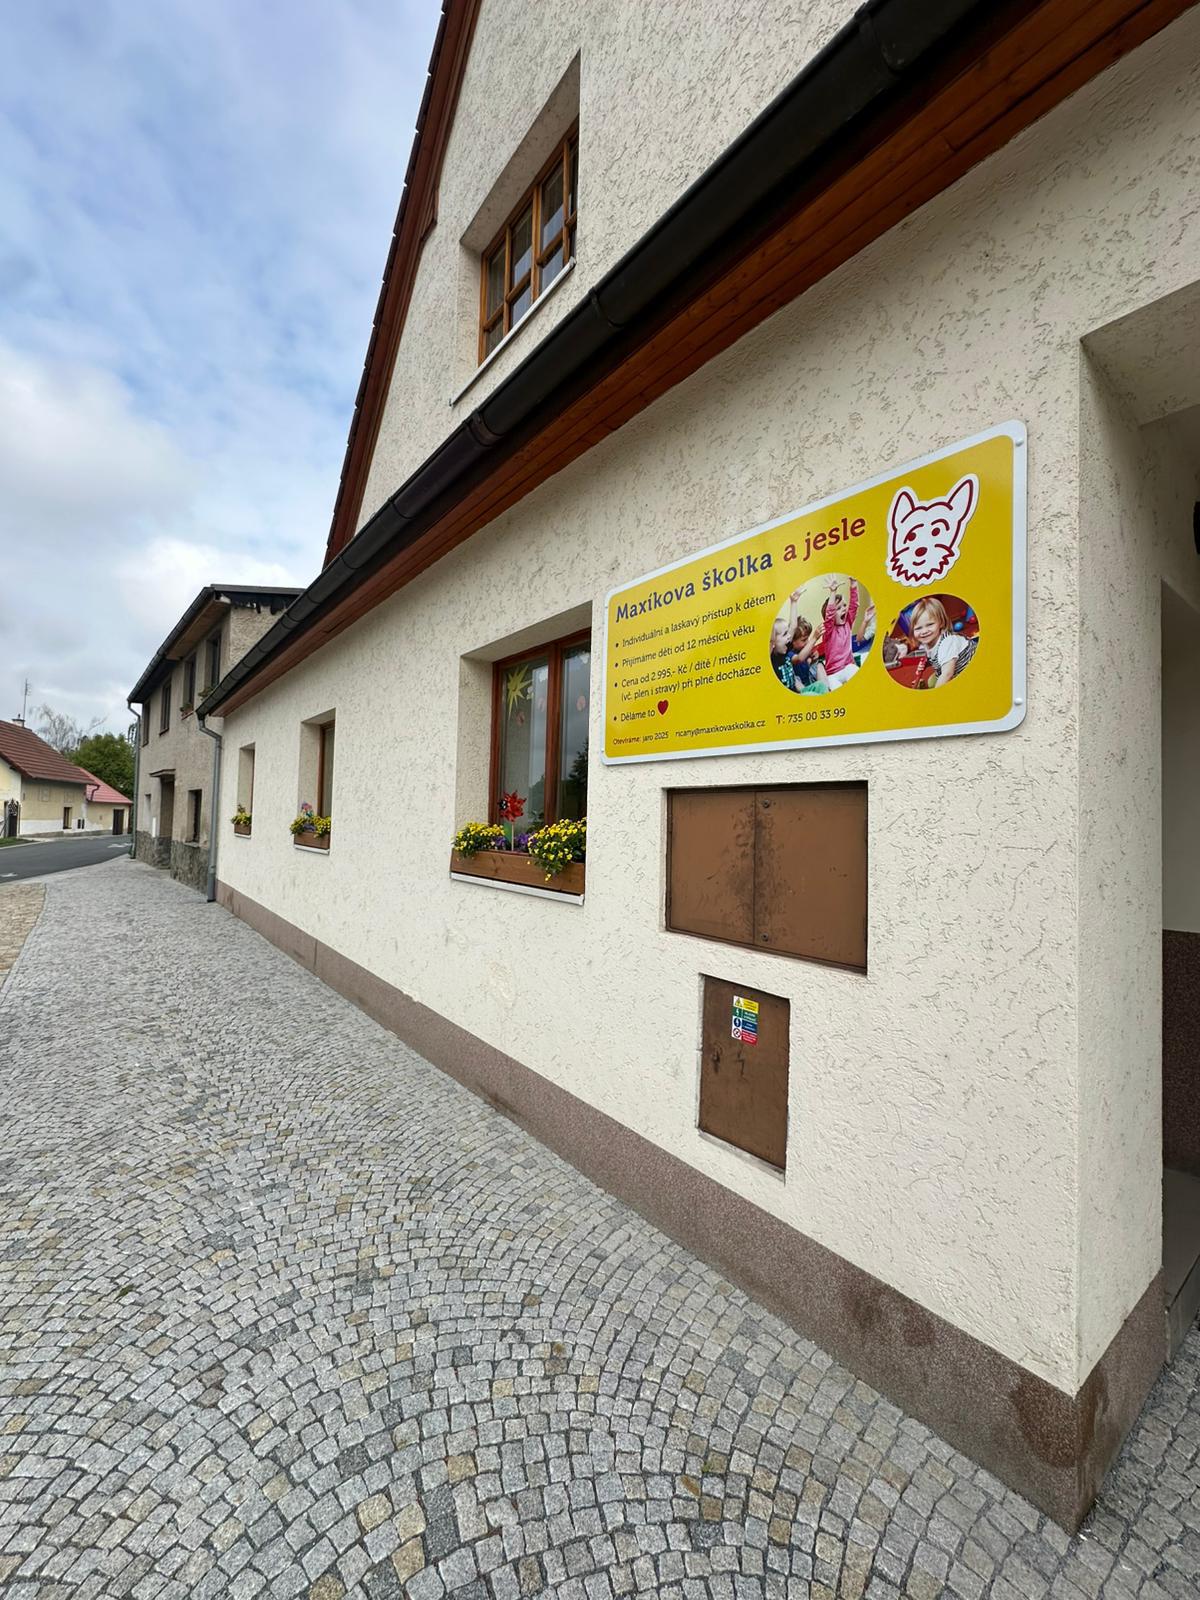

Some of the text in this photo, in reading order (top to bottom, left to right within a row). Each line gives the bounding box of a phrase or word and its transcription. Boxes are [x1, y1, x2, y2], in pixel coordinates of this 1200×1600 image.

[616, 517, 866, 623] Maxíkova školka a jesle
[622, 629, 663, 647] Individuální
[671, 615, 699, 631] laskavý
[702, 606, 733, 624] přístup
[735, 603, 741, 613] k
[743, 593, 776, 610] dětem
[658, 645, 673, 657] děti
[674, 642, 685, 653] od
[687, 639, 697, 650] 12
[698, 630, 730, 647] měsíců
[732, 625, 755, 637] věku
[621, 677, 639, 688] Cena
[640, 673, 650, 683] od
[678, 664, 688, 675] Kč
[689, 662, 693, 673] /
[694, 658, 711, 671] dítě
[713, 656, 717, 667] /
[719, 651, 746, 664] měsíc
[634, 688, 650, 699] plen
[655, 681, 680, 695] stravy)
[682, 677, 693, 691] při
[695, 674, 714, 688] plné
[716, 665, 761, 681] docházce
[620, 709, 655, 722] Děláme to
[776, 707, 846, 725] T: 735 00 33 99
[654, 730, 669, 740] 2025
